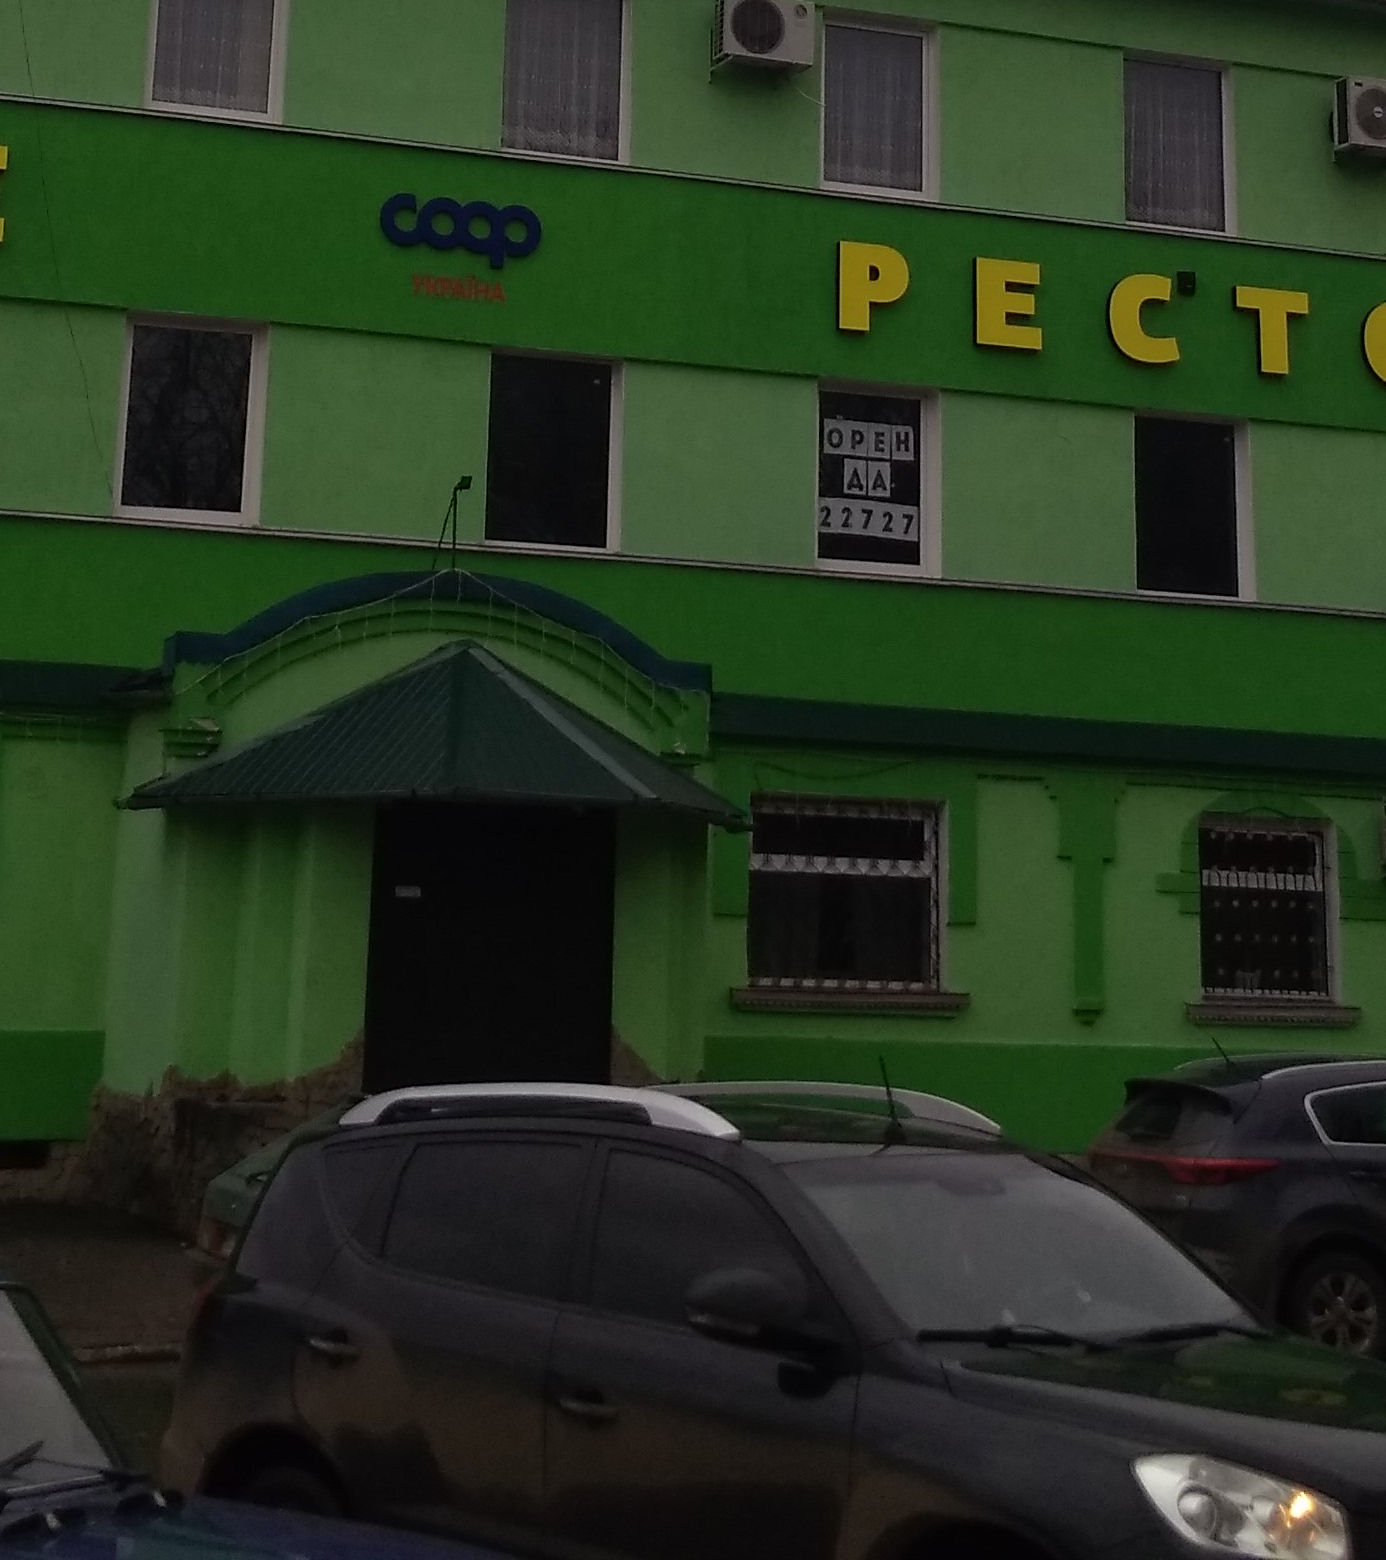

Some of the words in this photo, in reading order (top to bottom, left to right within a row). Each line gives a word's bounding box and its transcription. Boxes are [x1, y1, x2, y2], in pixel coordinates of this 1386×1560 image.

[380, 193, 541, 269] coop
[413, 273, 505, 302] УКРАЇНА
[827, 427, 910, 453] ОРЕН
[847, 467, 887, 492] ДА
[819, 505, 914, 535] 22727
